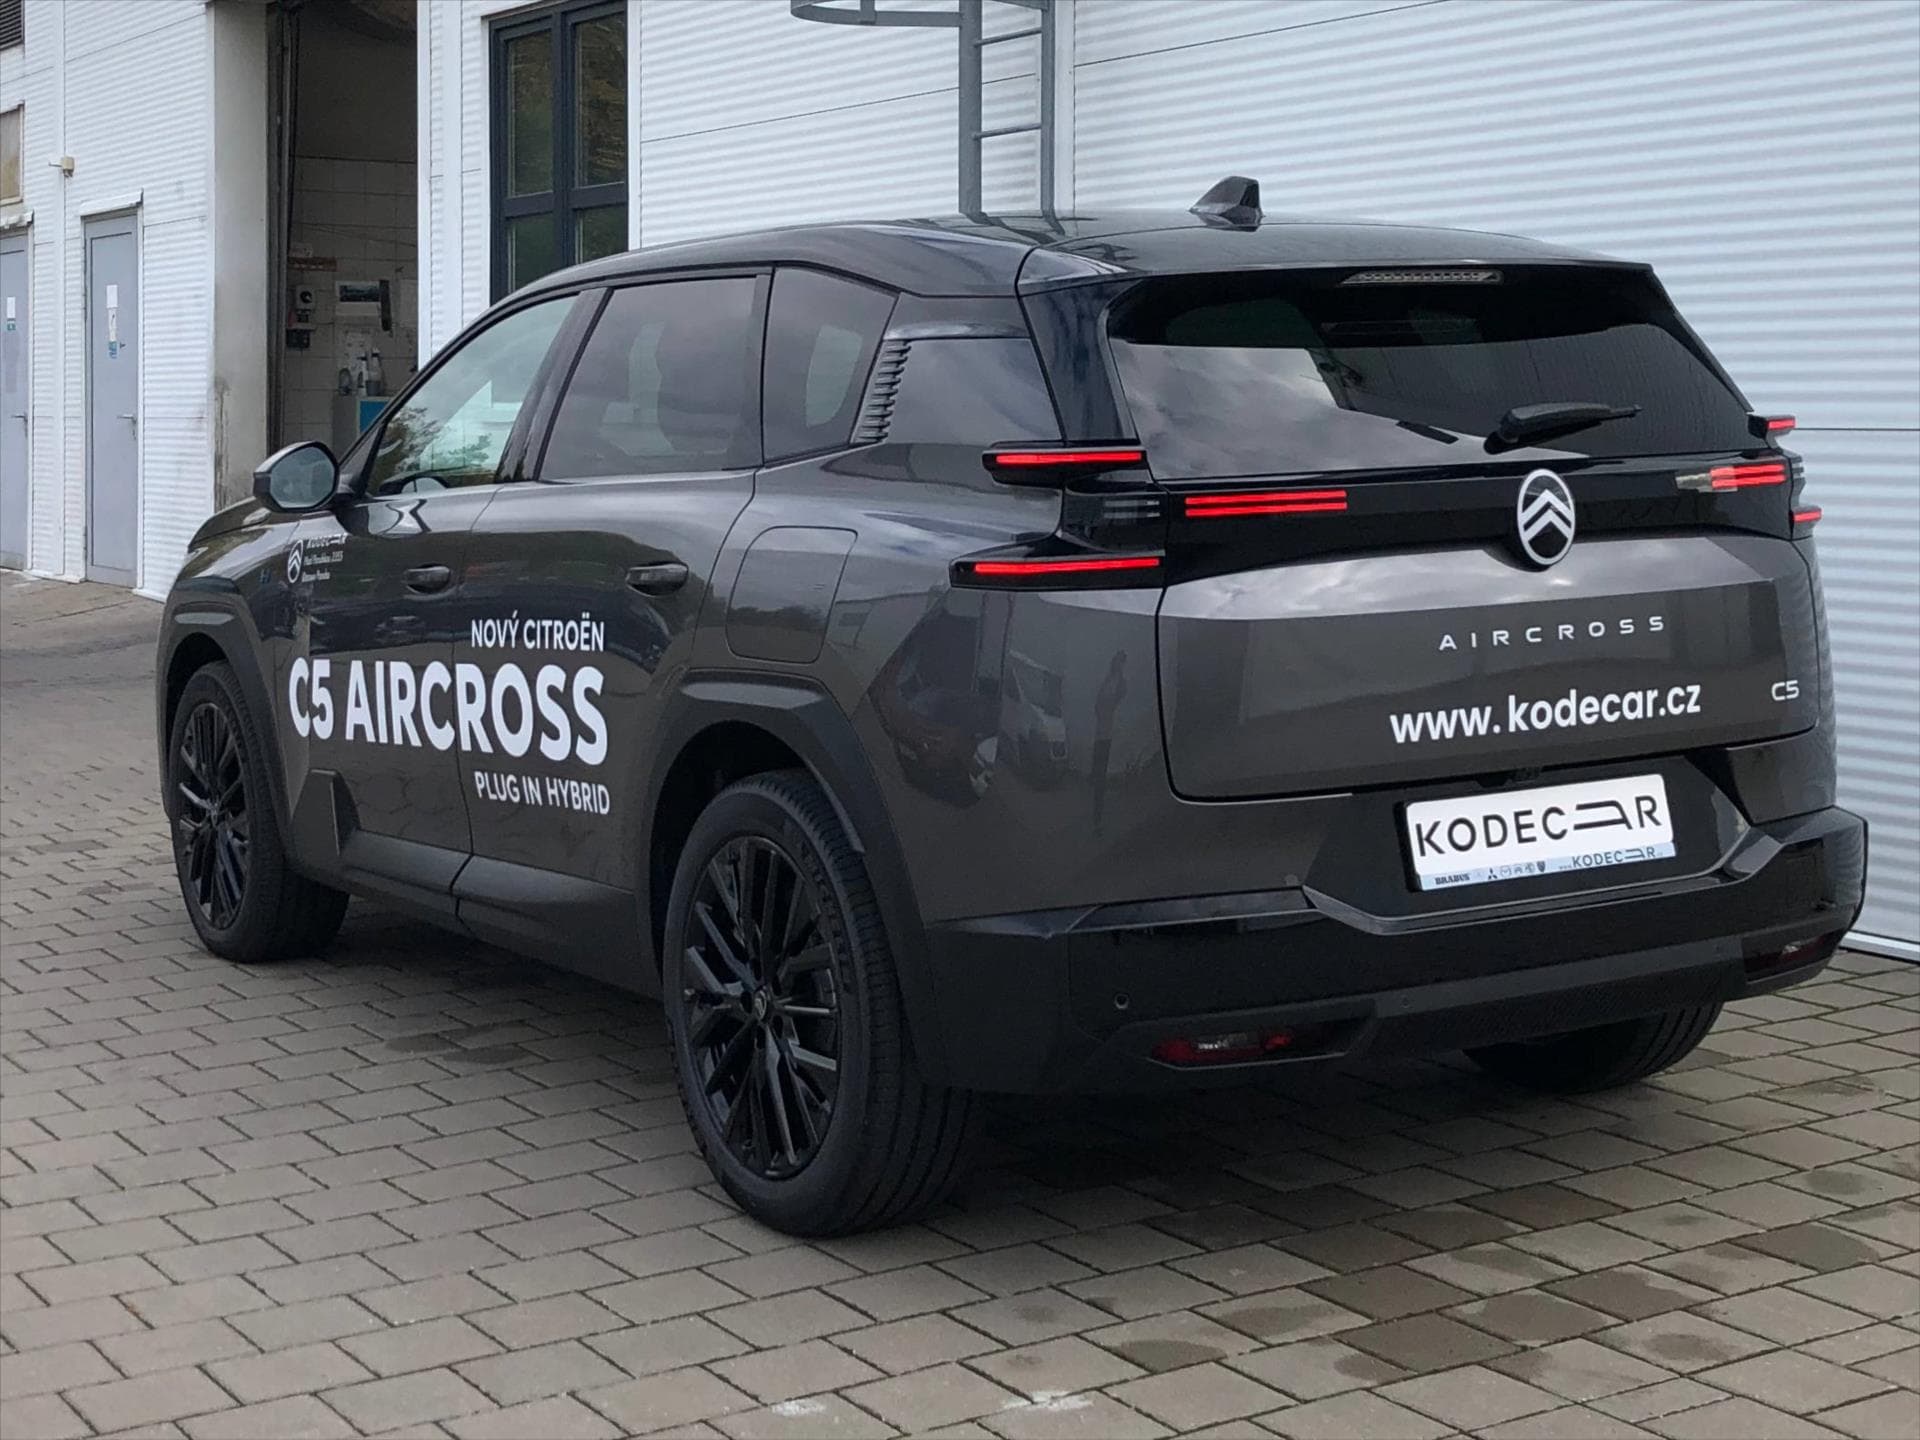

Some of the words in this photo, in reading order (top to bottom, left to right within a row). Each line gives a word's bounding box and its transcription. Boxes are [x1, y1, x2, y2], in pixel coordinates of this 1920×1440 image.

[471, 610, 518, 648] NOVÝ
[523, 612, 604, 652] CITROËN
[1439, 616, 1665, 650] AIRCROSS
[288, 657, 334, 740] C5
[345, 658, 608, 765] AIRCROSS
[1771, 680, 1799, 702] C5
[1390, 684, 1701, 743] www.kodecar.cz
[474, 770, 520, 804] PLUG
[523, 776, 541, 806] IN
[546, 778, 610, 815] HYBRID
[1434, 873, 1470, 885] BRABUS
